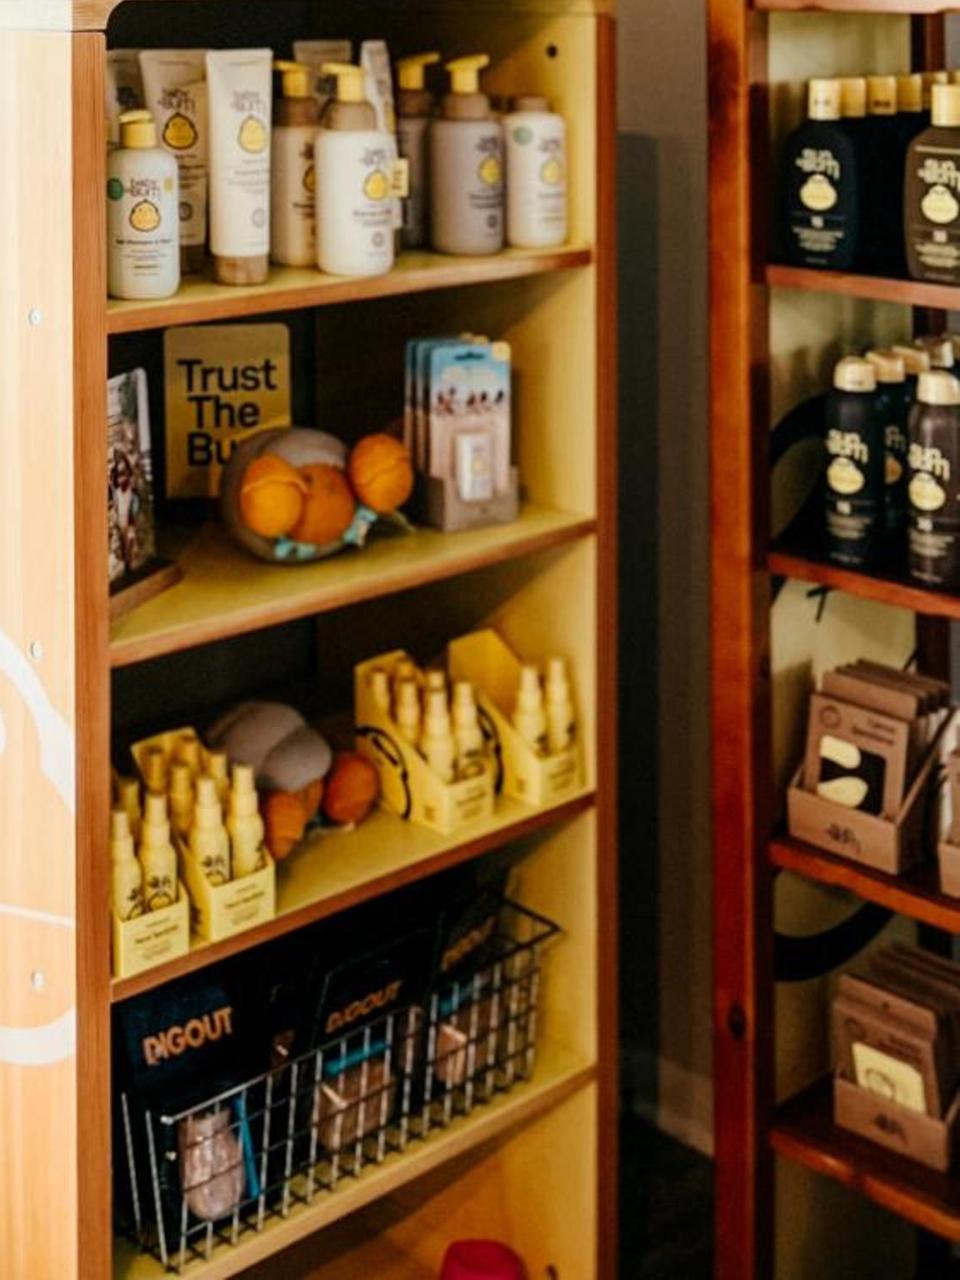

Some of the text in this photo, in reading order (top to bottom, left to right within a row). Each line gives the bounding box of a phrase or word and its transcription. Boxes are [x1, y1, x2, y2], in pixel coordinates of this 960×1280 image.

[176, 359, 278, 392] Trust
[187, 395, 259, 429] The
[188, 431, 237, 466] Bu
[143, 1005, 233, 1066] DIGOUT
